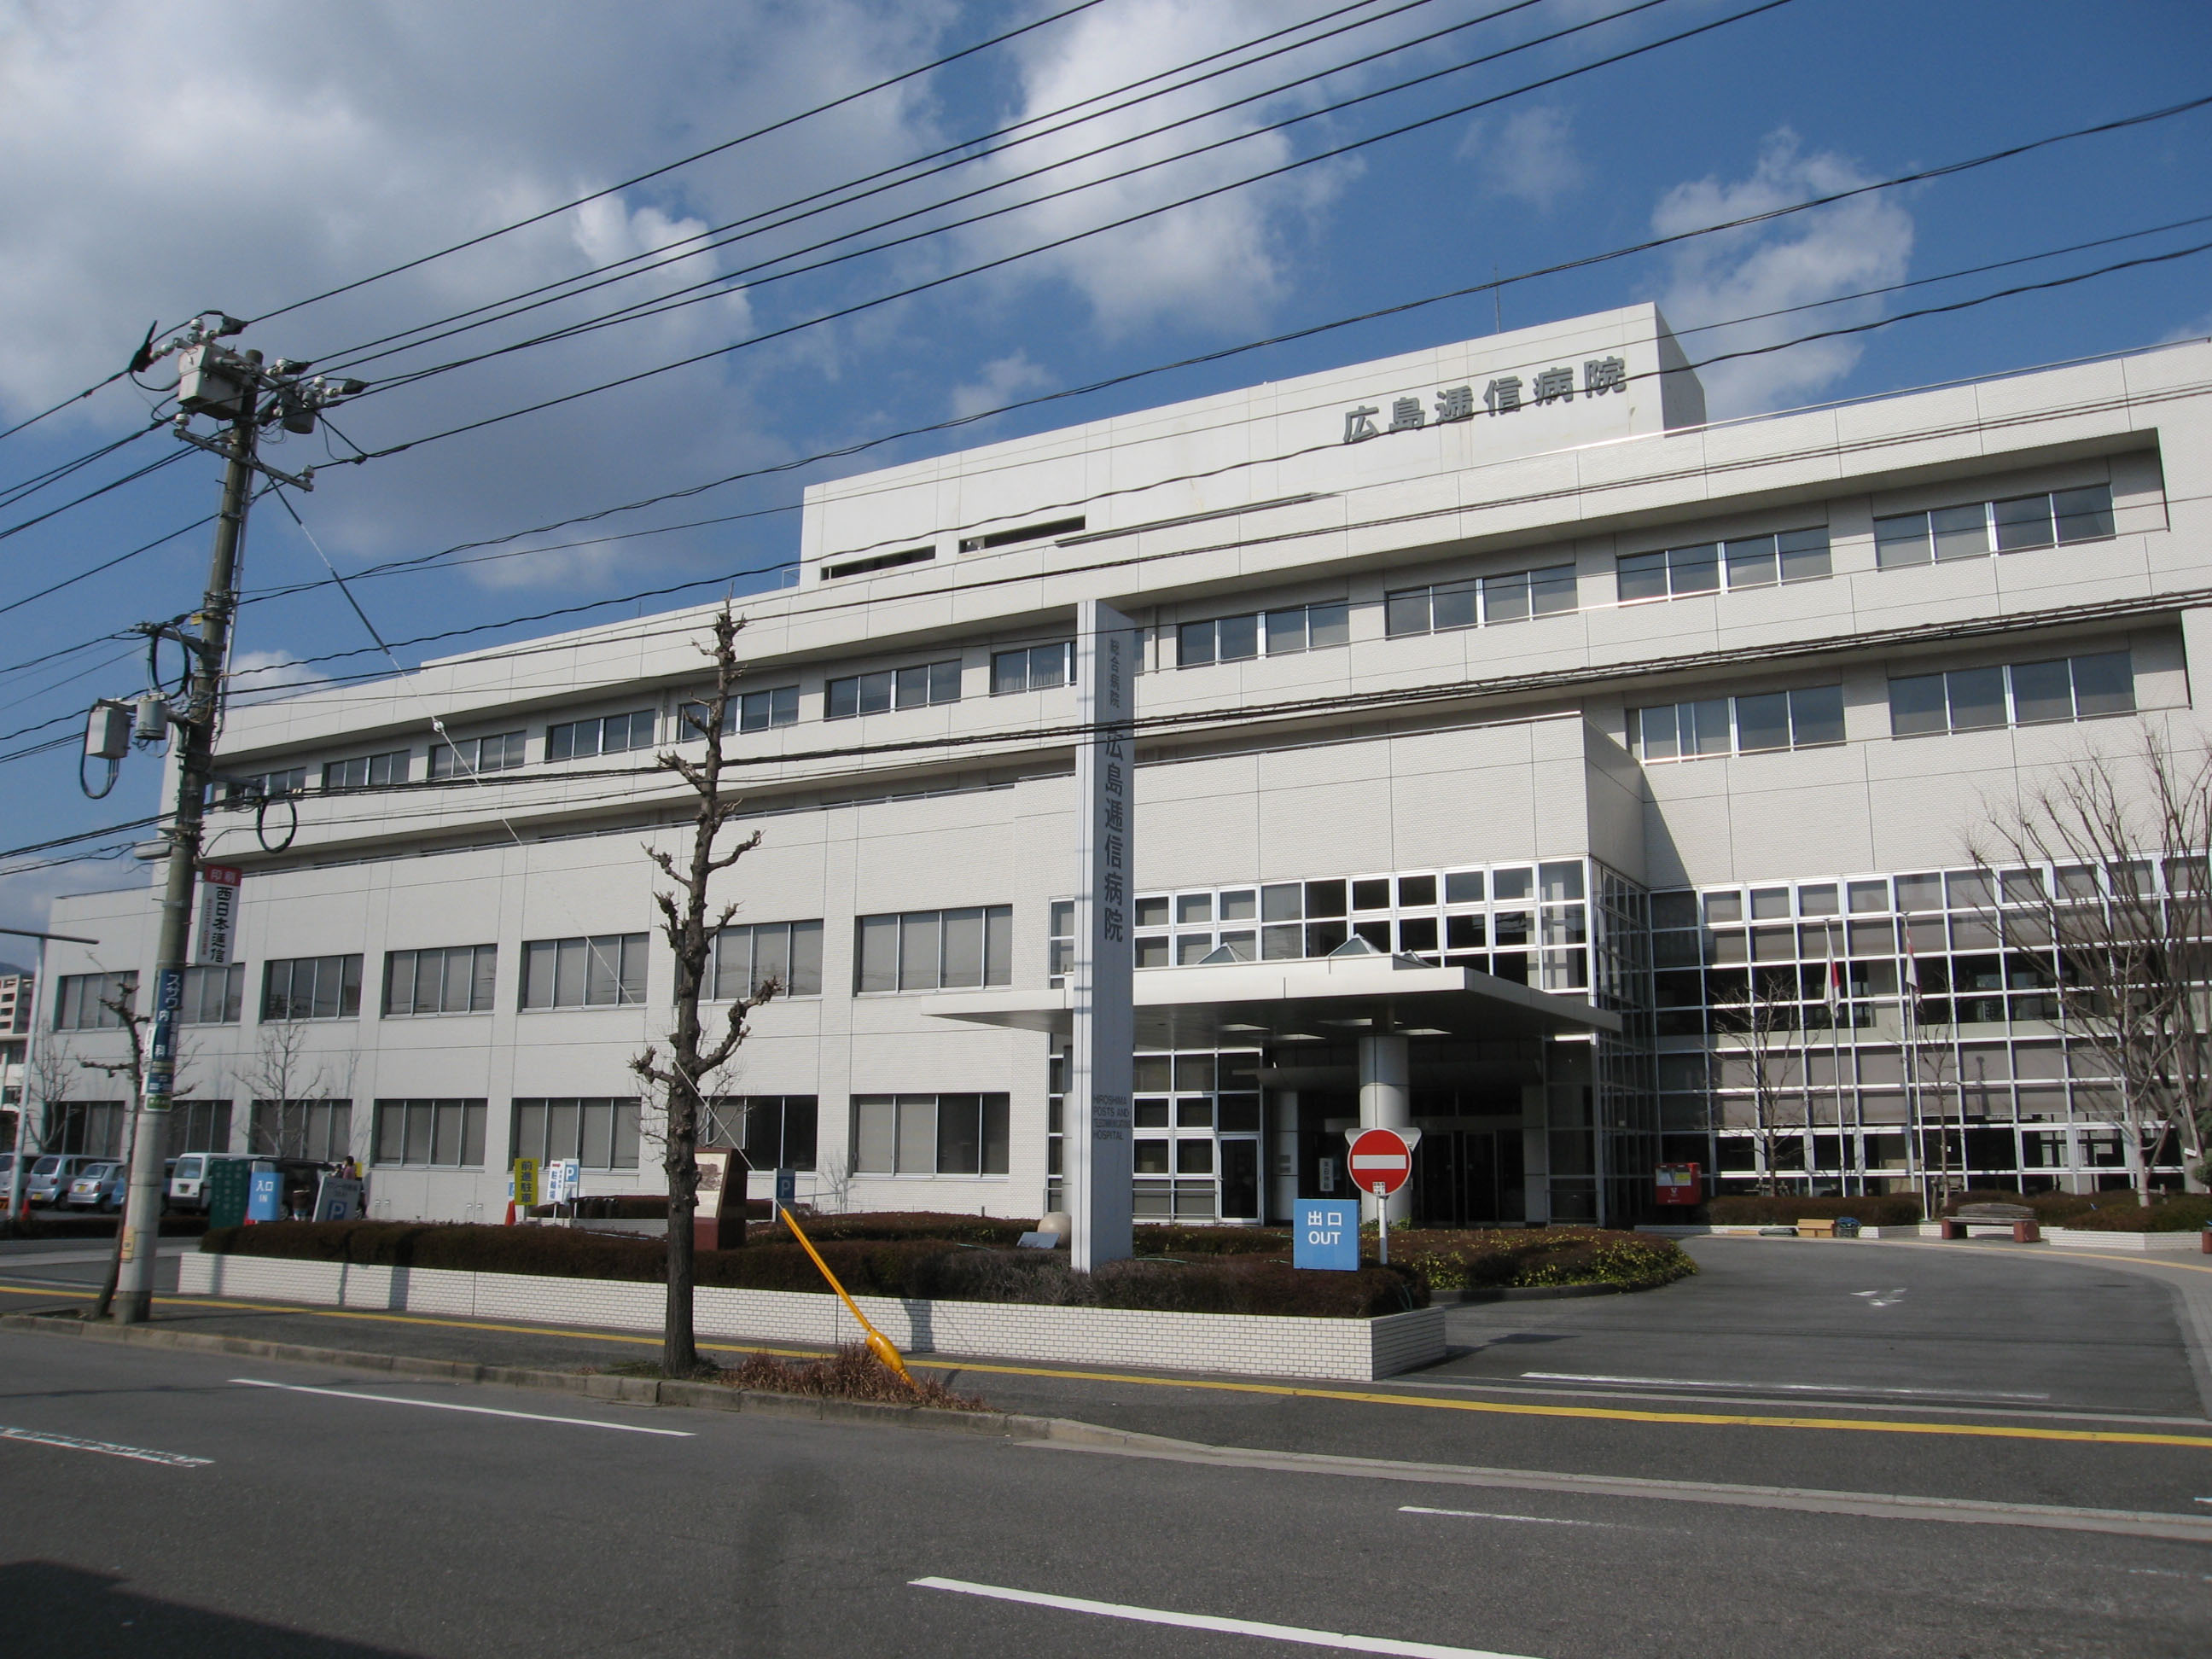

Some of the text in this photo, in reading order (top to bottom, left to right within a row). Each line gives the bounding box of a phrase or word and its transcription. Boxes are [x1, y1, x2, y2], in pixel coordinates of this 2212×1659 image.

[1093, 1094, 1127, 1106] HIROSHIMA
[1093, 1106, 1130, 1118] POSTS AND
[1093, 1129, 1124, 1141] HOSPITAL
[566, 1167, 574, 1181] P
[256, 1179, 274, 1192] 入口
[782, 1179, 791, 1196] P
[259, 1194, 268, 1202] IN
[1307, 1210, 1342, 1226] 出口
[1308, 1231, 1342, 1245] OUT
